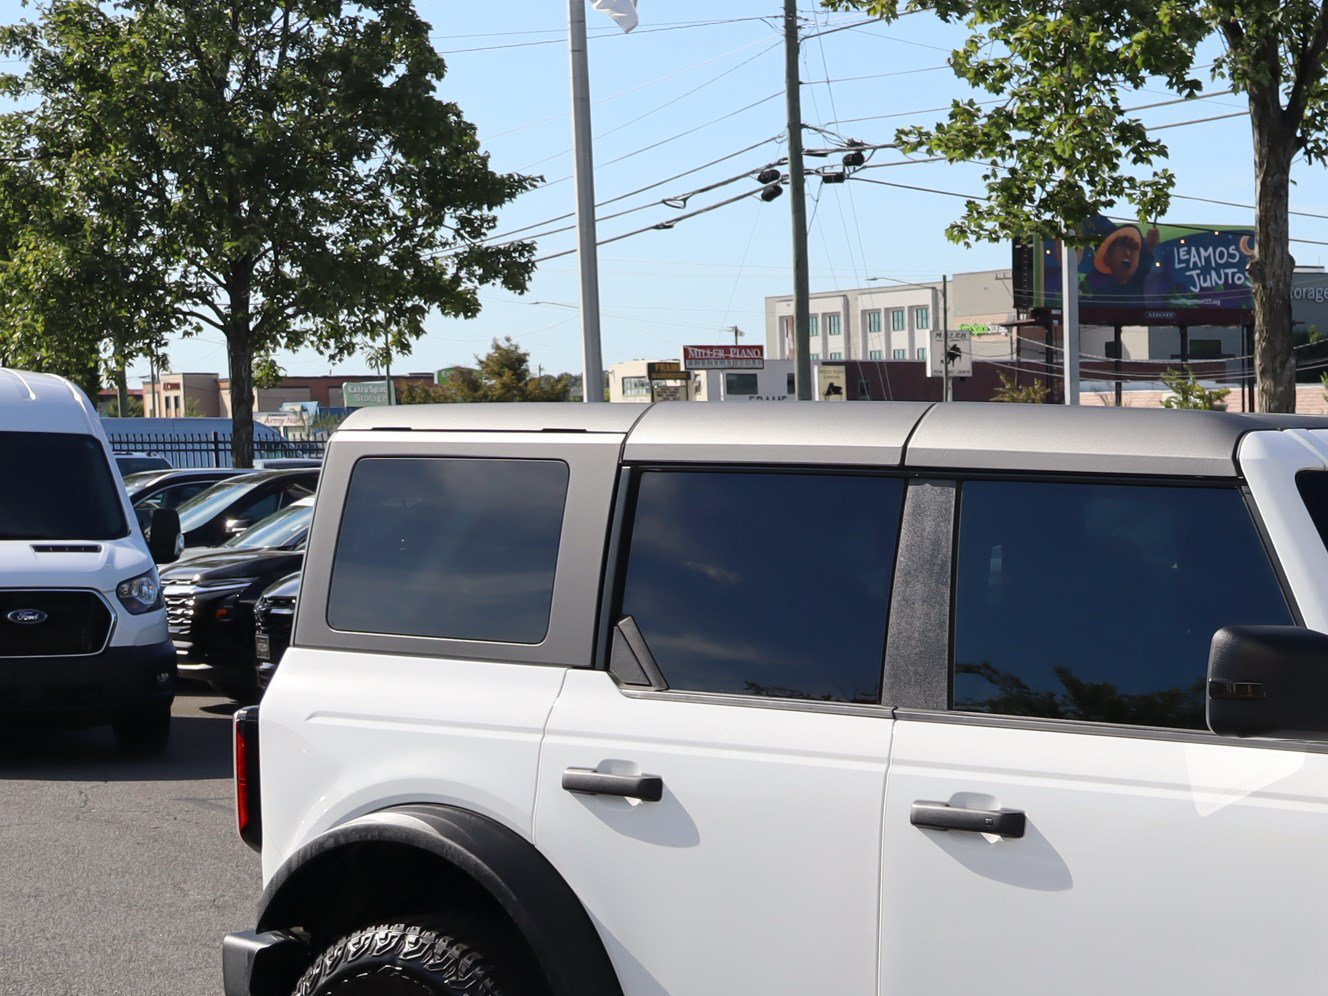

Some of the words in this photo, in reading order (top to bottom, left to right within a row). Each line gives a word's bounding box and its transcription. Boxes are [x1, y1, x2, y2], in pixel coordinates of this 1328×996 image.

[1174, 245, 1240, 269] LEAMOS
[688, 348, 725, 358] MILLER
[730, 347, 762, 358] PIANO
